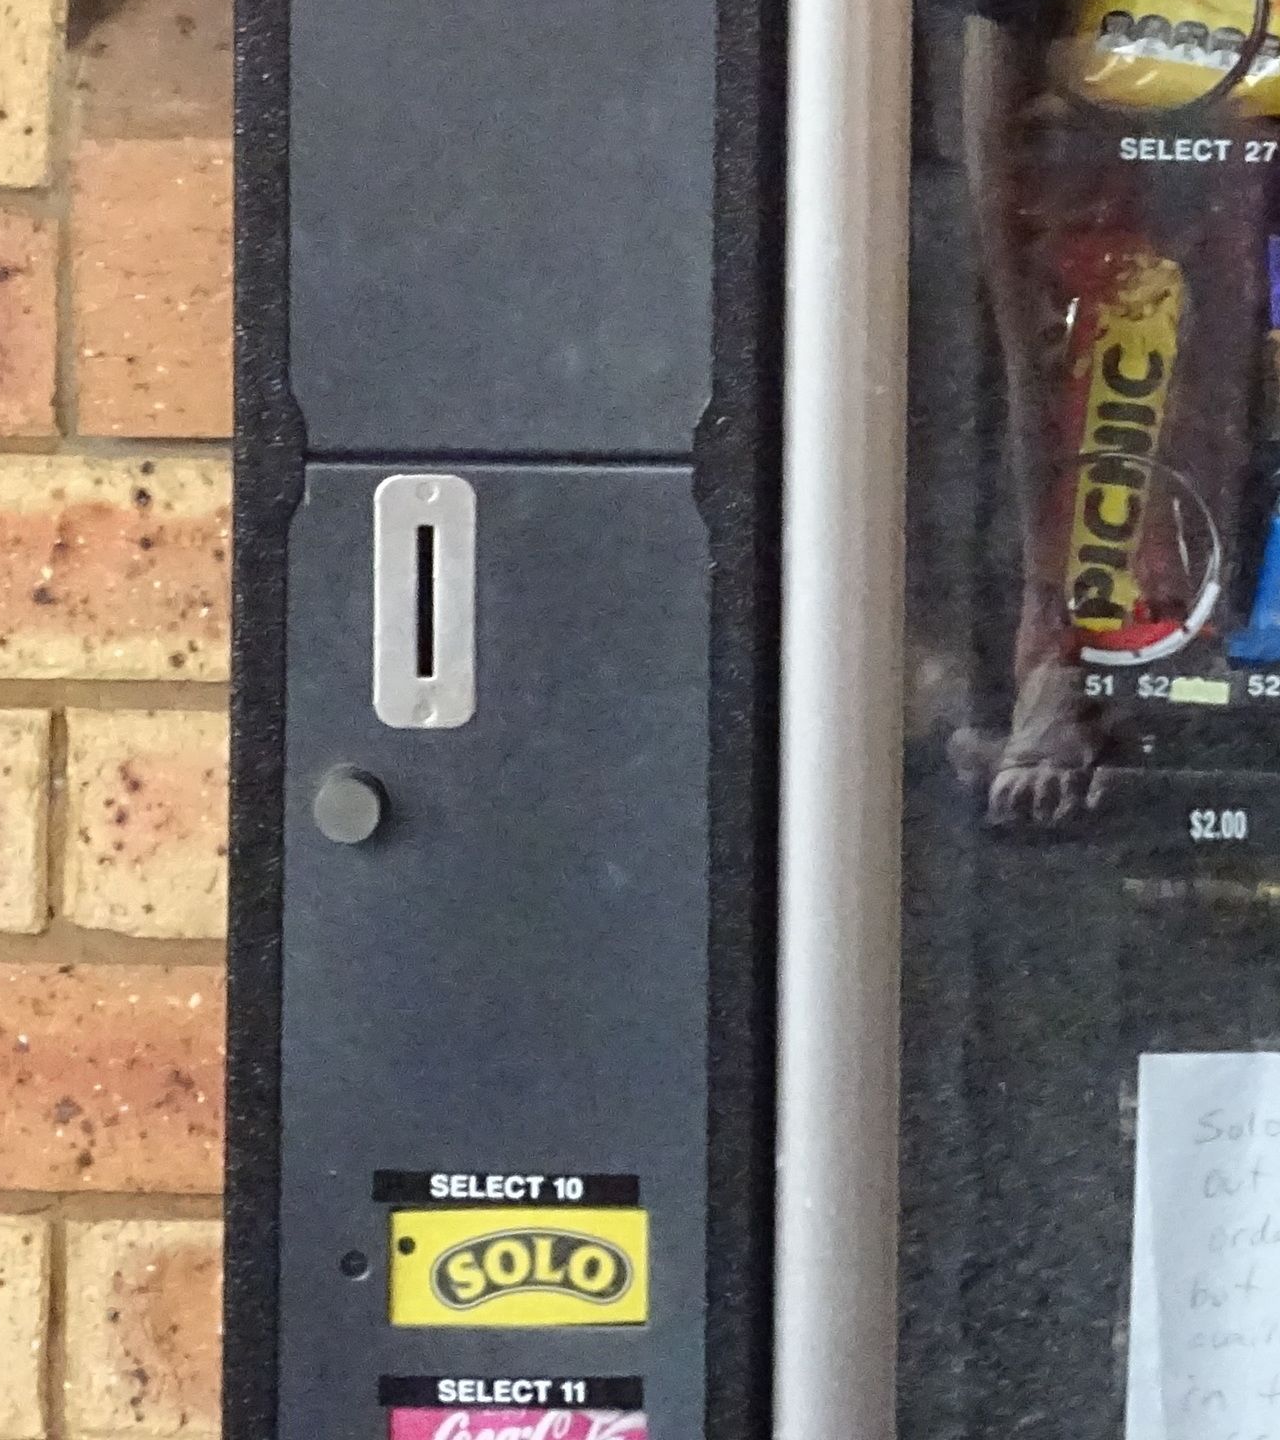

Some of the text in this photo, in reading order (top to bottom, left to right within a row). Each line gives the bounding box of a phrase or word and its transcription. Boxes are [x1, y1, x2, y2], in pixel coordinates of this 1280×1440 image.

[1120, 138, 1277, 162] SELECT 27
[1085, 674, 1115, 696] 51
[1189, 808, 1248, 840] $2.00
[429, 1173, 584, 1200] SELECT 10
[445, 1236, 617, 1301] SOLO
[437, 1379, 586, 1404] SELECT 11
